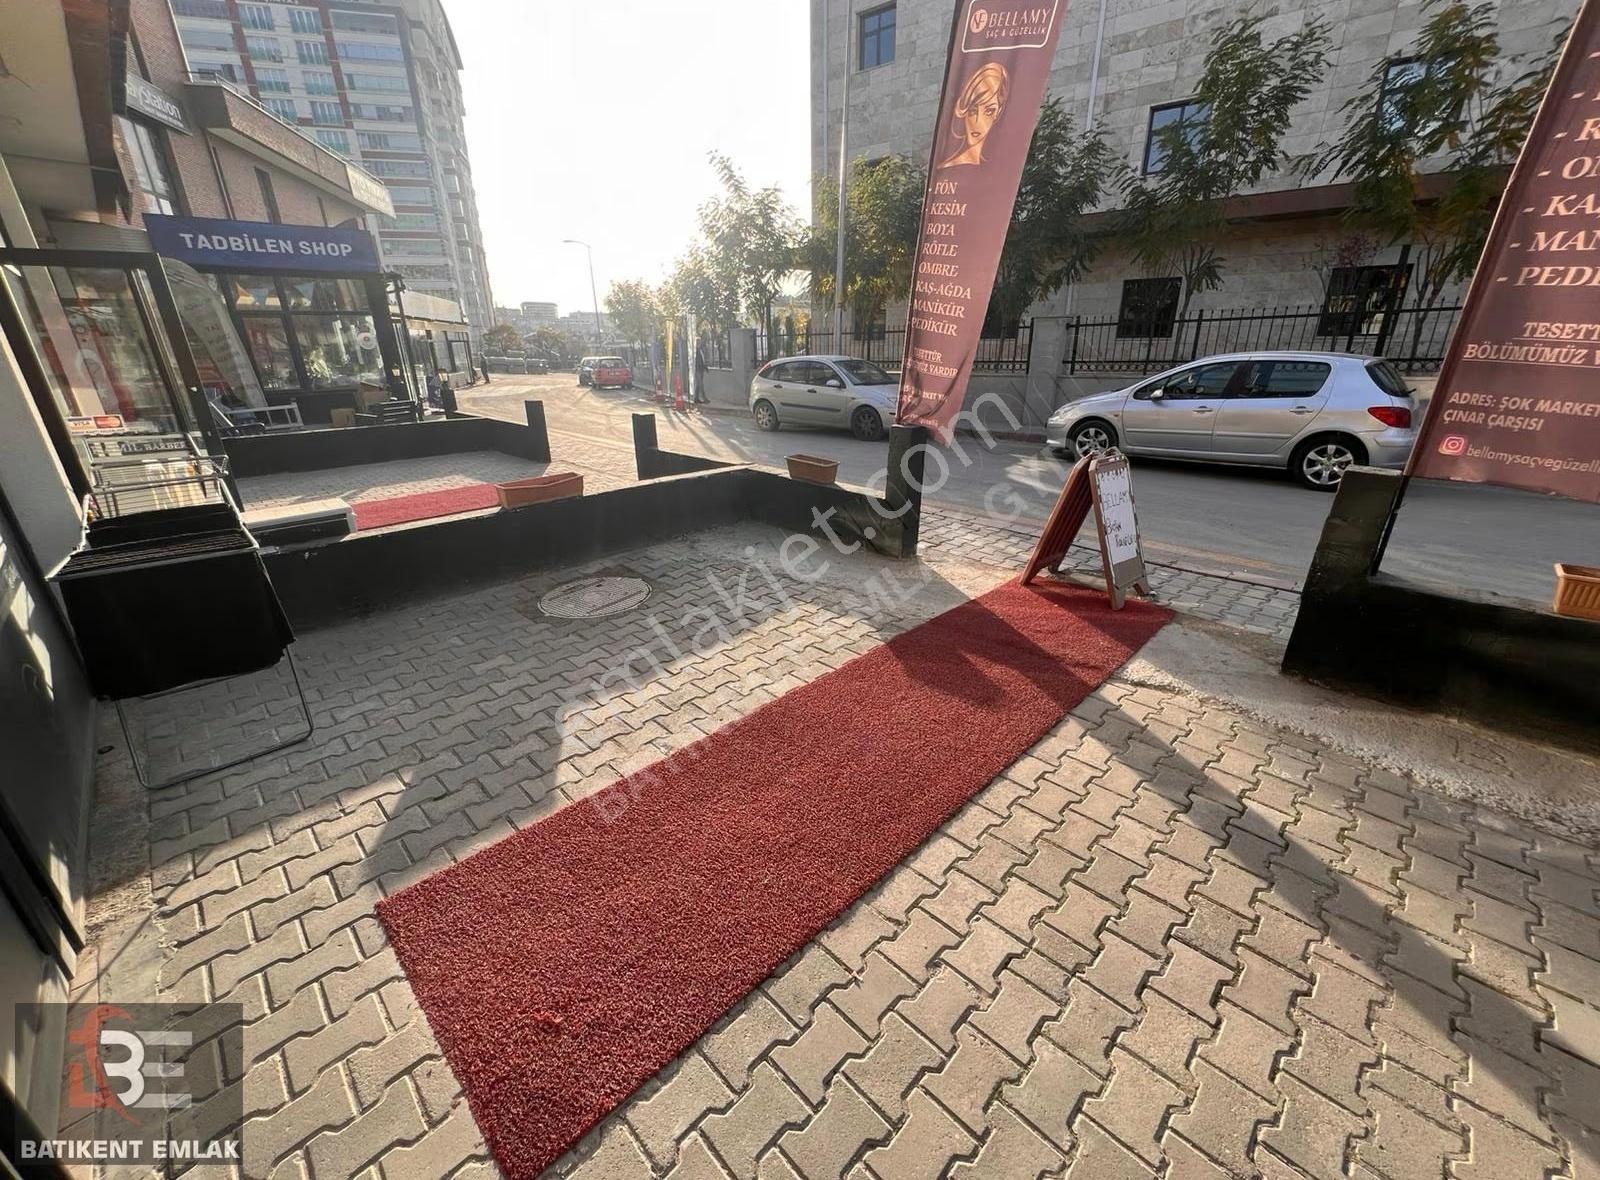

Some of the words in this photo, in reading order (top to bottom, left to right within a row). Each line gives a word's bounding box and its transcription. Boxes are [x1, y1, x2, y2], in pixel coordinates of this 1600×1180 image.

[988, 8, 1050, 28] BELLAMY
[985, 29, 998, 39] SAÇ
[934, 180, 958, 196] FÖN
[930, 199, 967, 217] KESİM
[926, 222, 955, 237] BOYA
[179, 233, 294, 255] TADBİLEN
[299, 240, 353, 258] SHOP
[922, 240, 958, 257] RÖFLE
[919, 262, 959, 278] OMBRE
[915, 280, 972, 300] KAŞ-AĞDA
[913, 299, 965, 319] MANİKÜR
[911, 317, 958, 337] PEDİKÜR
[1463, 340, 1588, 365] BÖLÜMÜMÜZ
[1449, 391, 1497, 408] ADRES:
[1500, 396, 1533, 413] ŞOK
[1443, 408, 1485, 425] ÇINAR
[1487, 413, 1544, 432] ÇARŞISI
